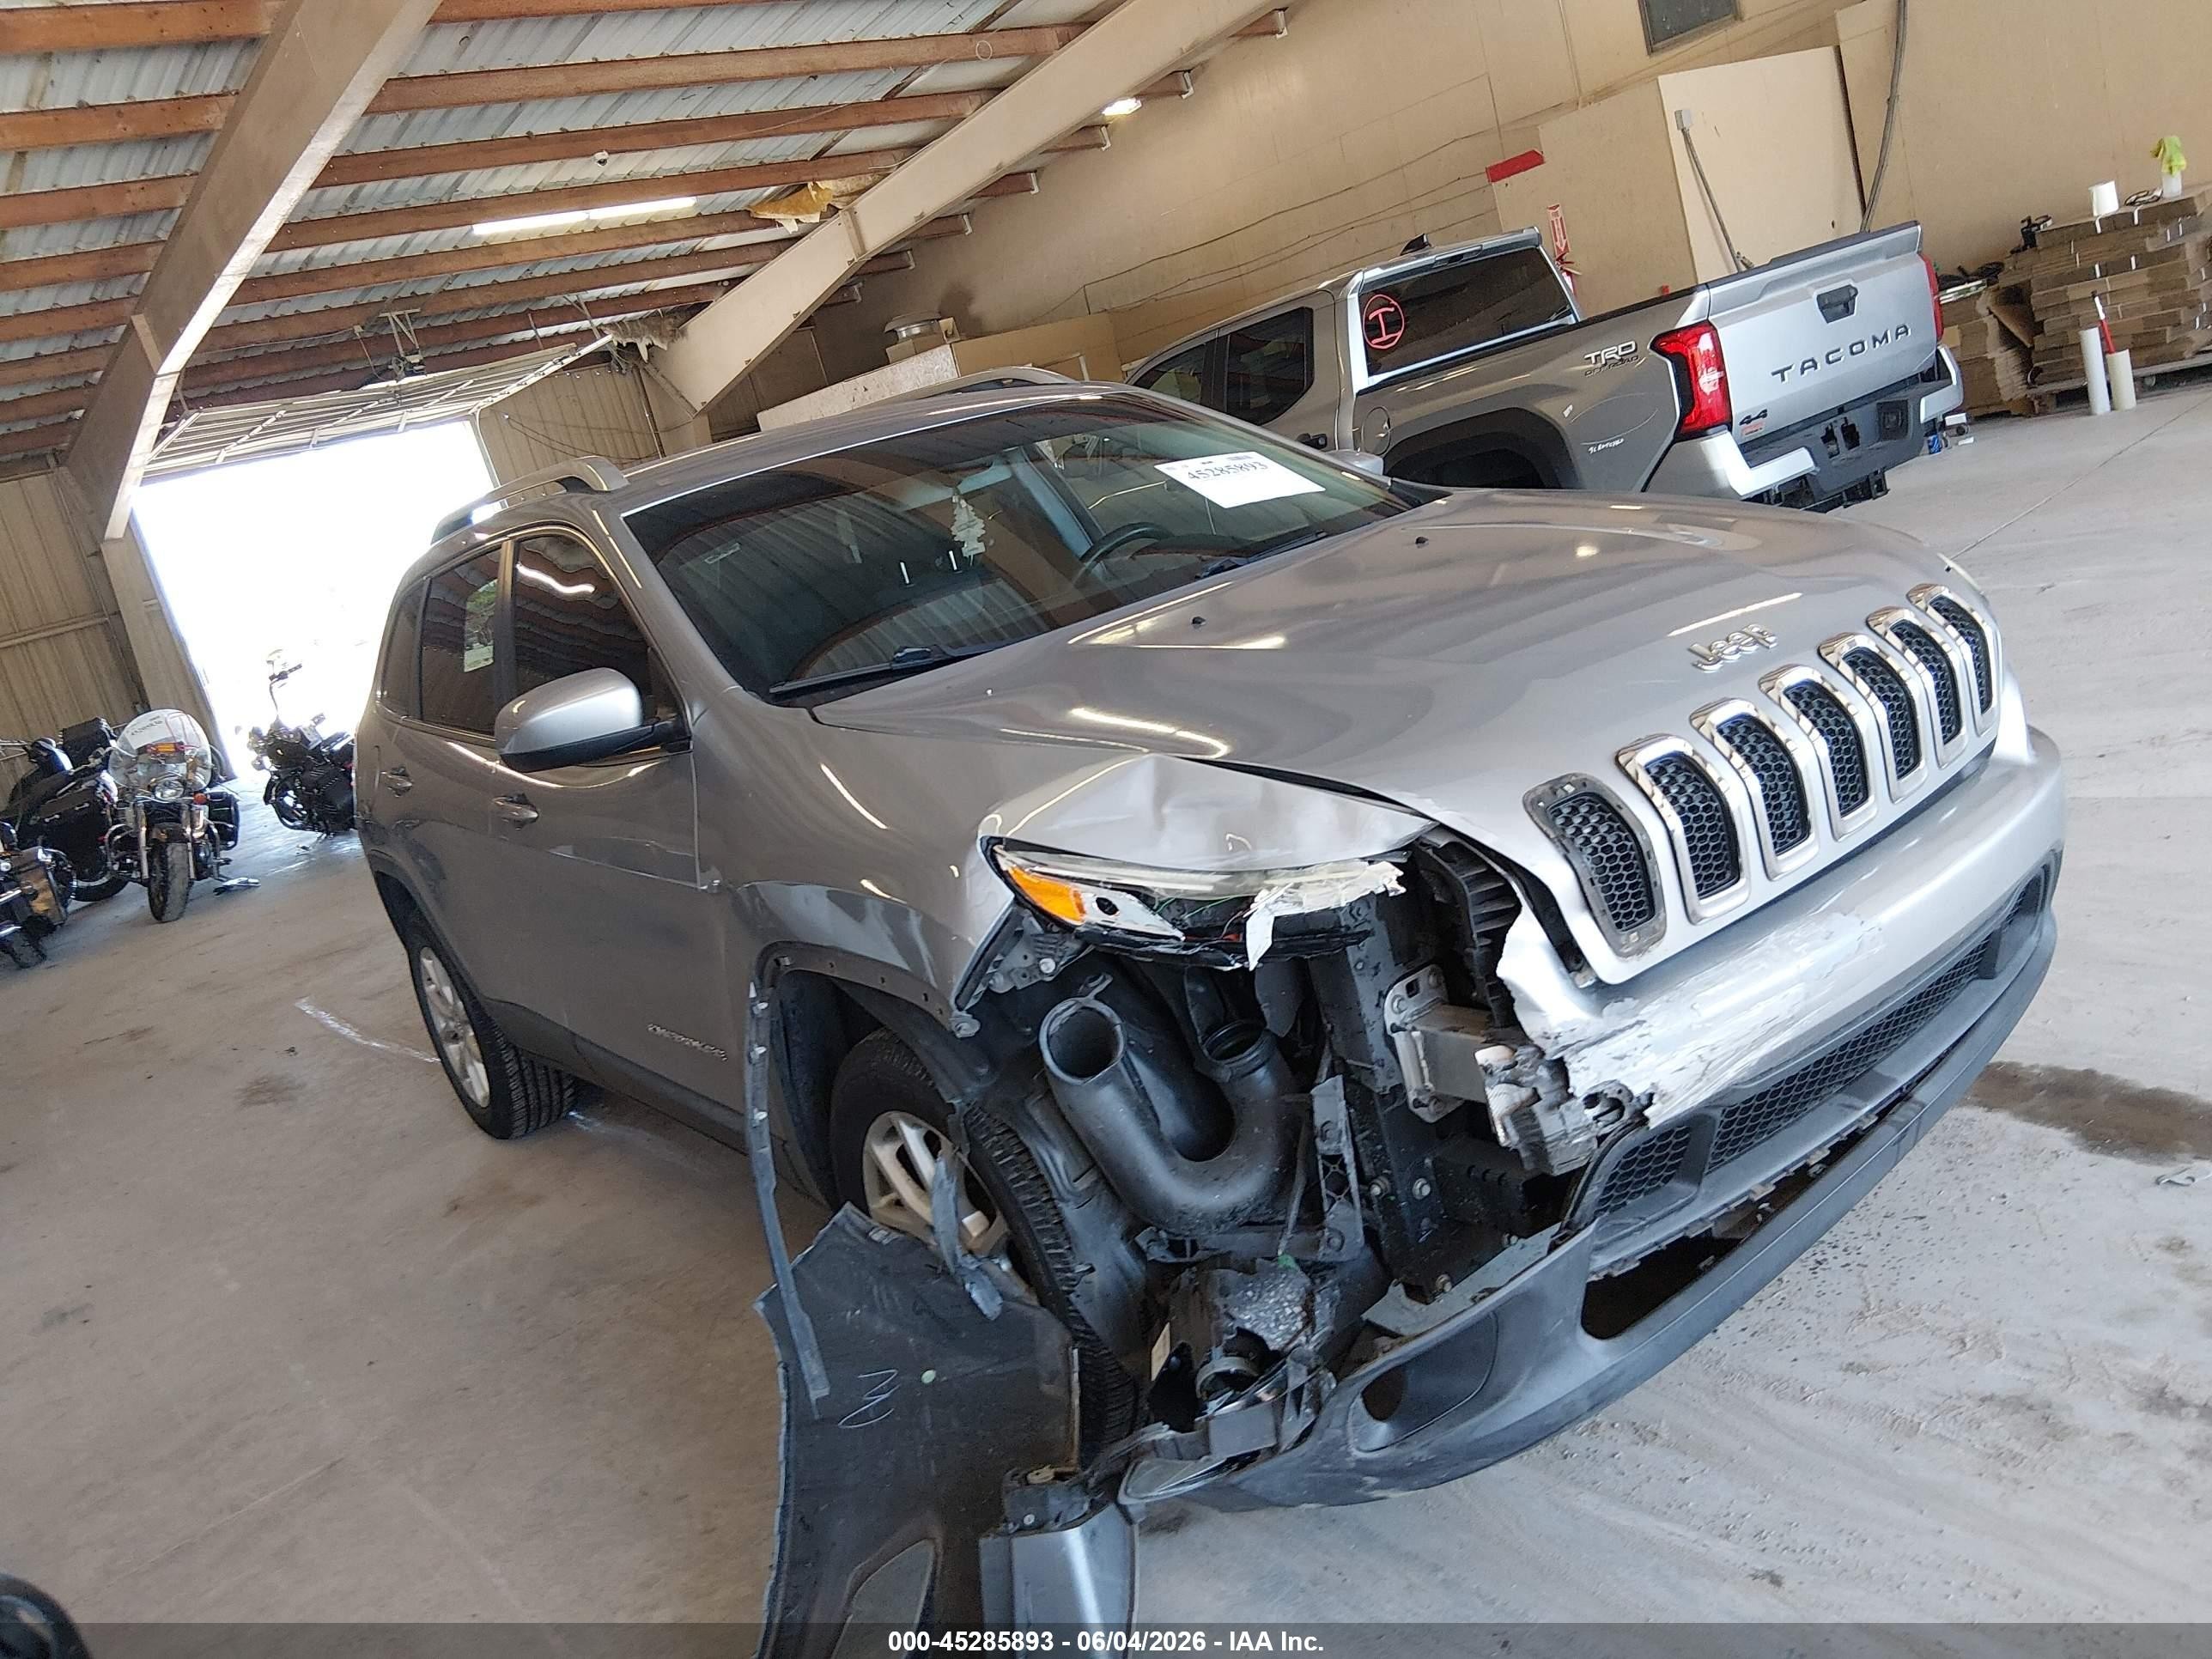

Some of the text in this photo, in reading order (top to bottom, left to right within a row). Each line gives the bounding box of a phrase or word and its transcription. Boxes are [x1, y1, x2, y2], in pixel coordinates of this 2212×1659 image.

[1583, 339, 1637, 366] TRD
[1771, 323, 1911, 384] TACOMA
[1687, 623, 1778, 672] Jeep
